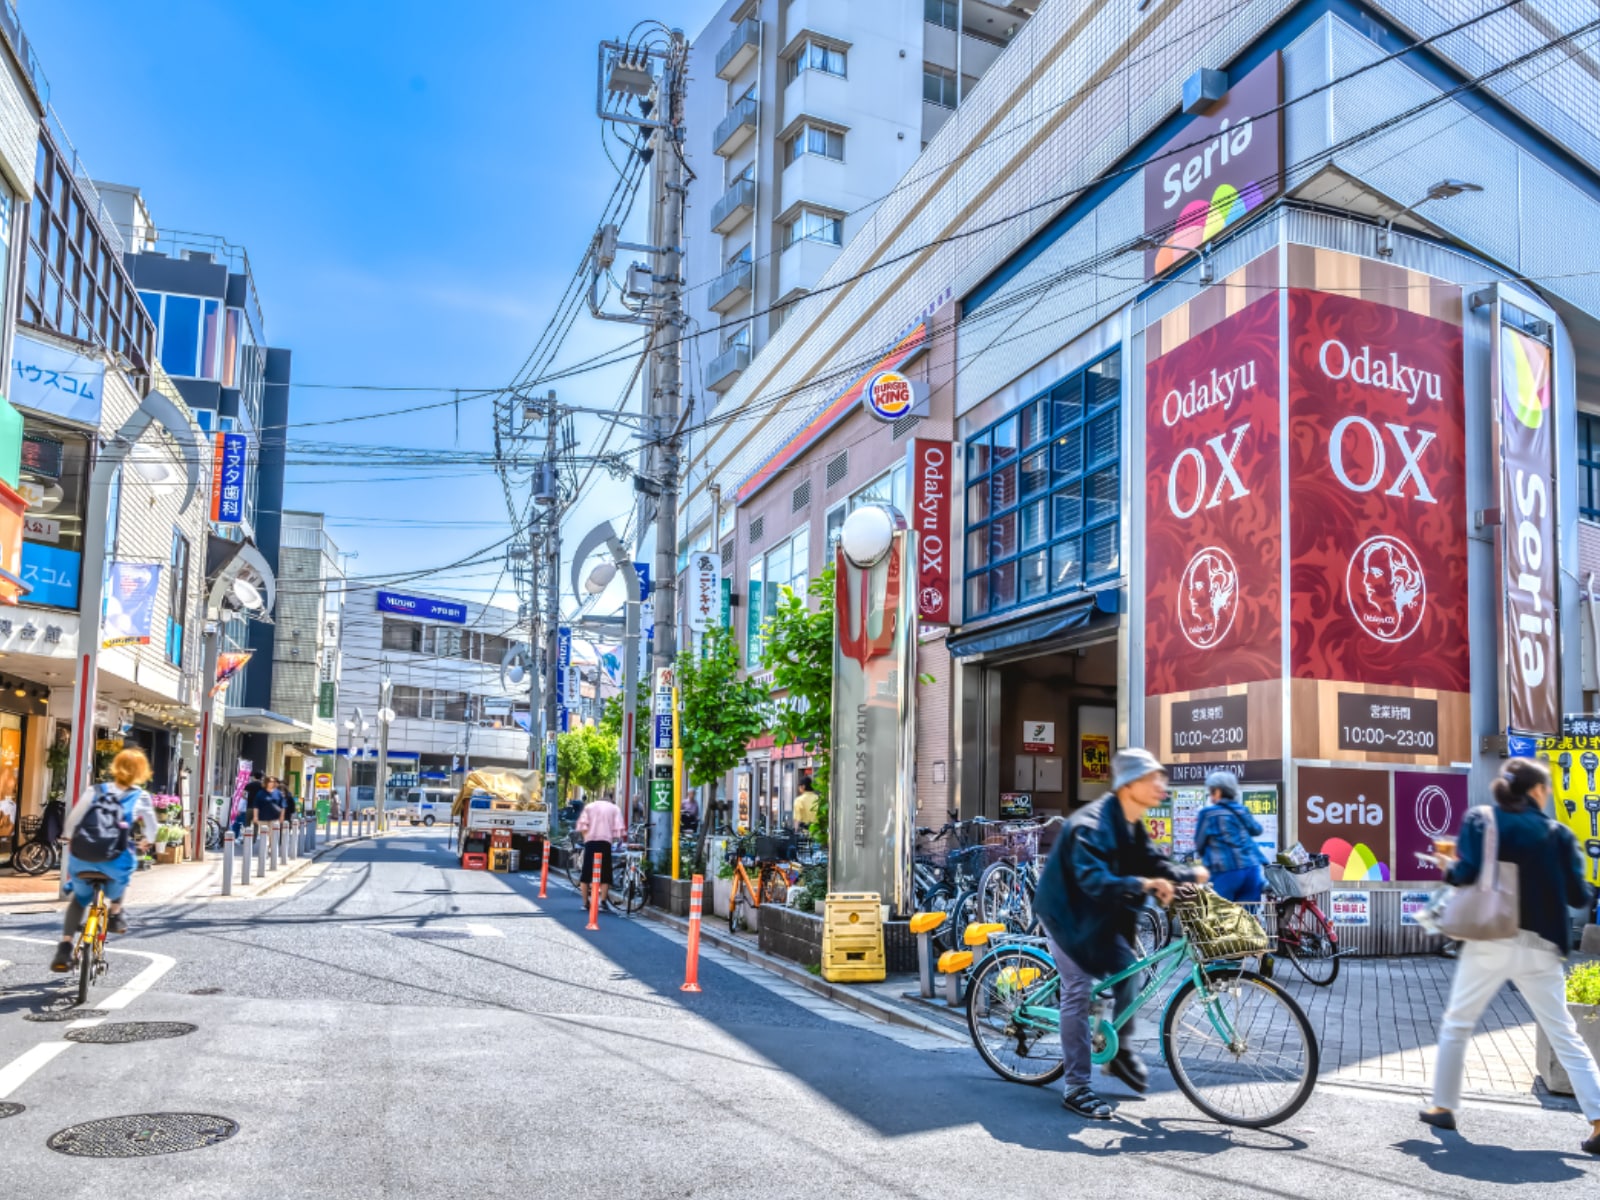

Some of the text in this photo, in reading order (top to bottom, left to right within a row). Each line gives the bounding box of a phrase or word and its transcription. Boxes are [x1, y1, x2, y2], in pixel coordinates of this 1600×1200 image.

[1163, 116, 1253, 210] Seria
[12, 359, 95, 400] ハウスコム
[874, 381, 908, 395] BURGER
[875, 388, 909, 405] KING
[1162, 360, 1257, 427] Odakyu
[1319, 339, 1443, 405] Odakyu
[223, 440, 242, 516] キヌタ歯科
[1168, 422, 1250, 519] OX
[1329, 415, 1438, 504] OX
[919, 447, 944, 574] Odakyu OX
[386, 597, 416, 609] MIZUHO
[1515, 469, 1552, 687] Seria
[856, 703, 866, 745] ULTRA
[1370, 703, 1411, 721] 営業時間
[1173, 763, 1245, 780] INFORMION
[1306, 795, 1383, 825] Seria
